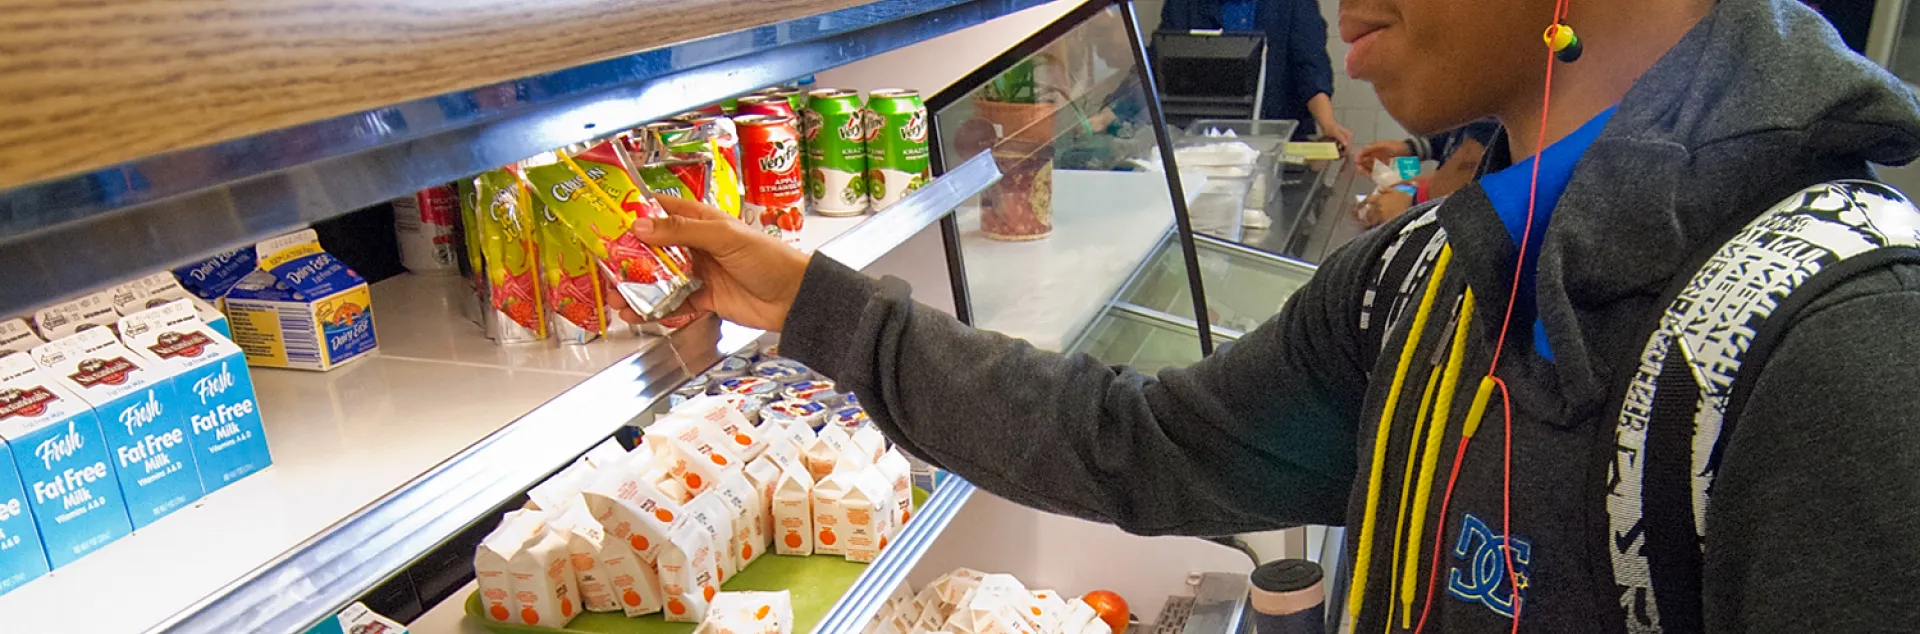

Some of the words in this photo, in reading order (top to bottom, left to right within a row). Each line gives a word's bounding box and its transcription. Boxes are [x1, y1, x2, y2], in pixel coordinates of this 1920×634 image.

[190, 257, 222, 281] Dairy
[286, 265, 316, 285] Dairy
[330, 329, 353, 351] Dairy
[192, 361, 235, 405] Fresh
[118, 388, 163, 436] Fresh
[190, 410, 219, 435] Fat
[216, 398, 253, 423] Free
[34, 420, 85, 471] Fresh
[215, 421, 241, 441] Milk
[117, 440, 147, 468] Fat
[144, 428, 184, 455] Free
[144, 452, 171, 474] Milk
[32, 474, 66, 505] Fat
[63, 461, 107, 491] Free
[0, 498, 21, 521] ee
[63, 487, 93, 511] Milk
[1448, 512, 1530, 619] DC
